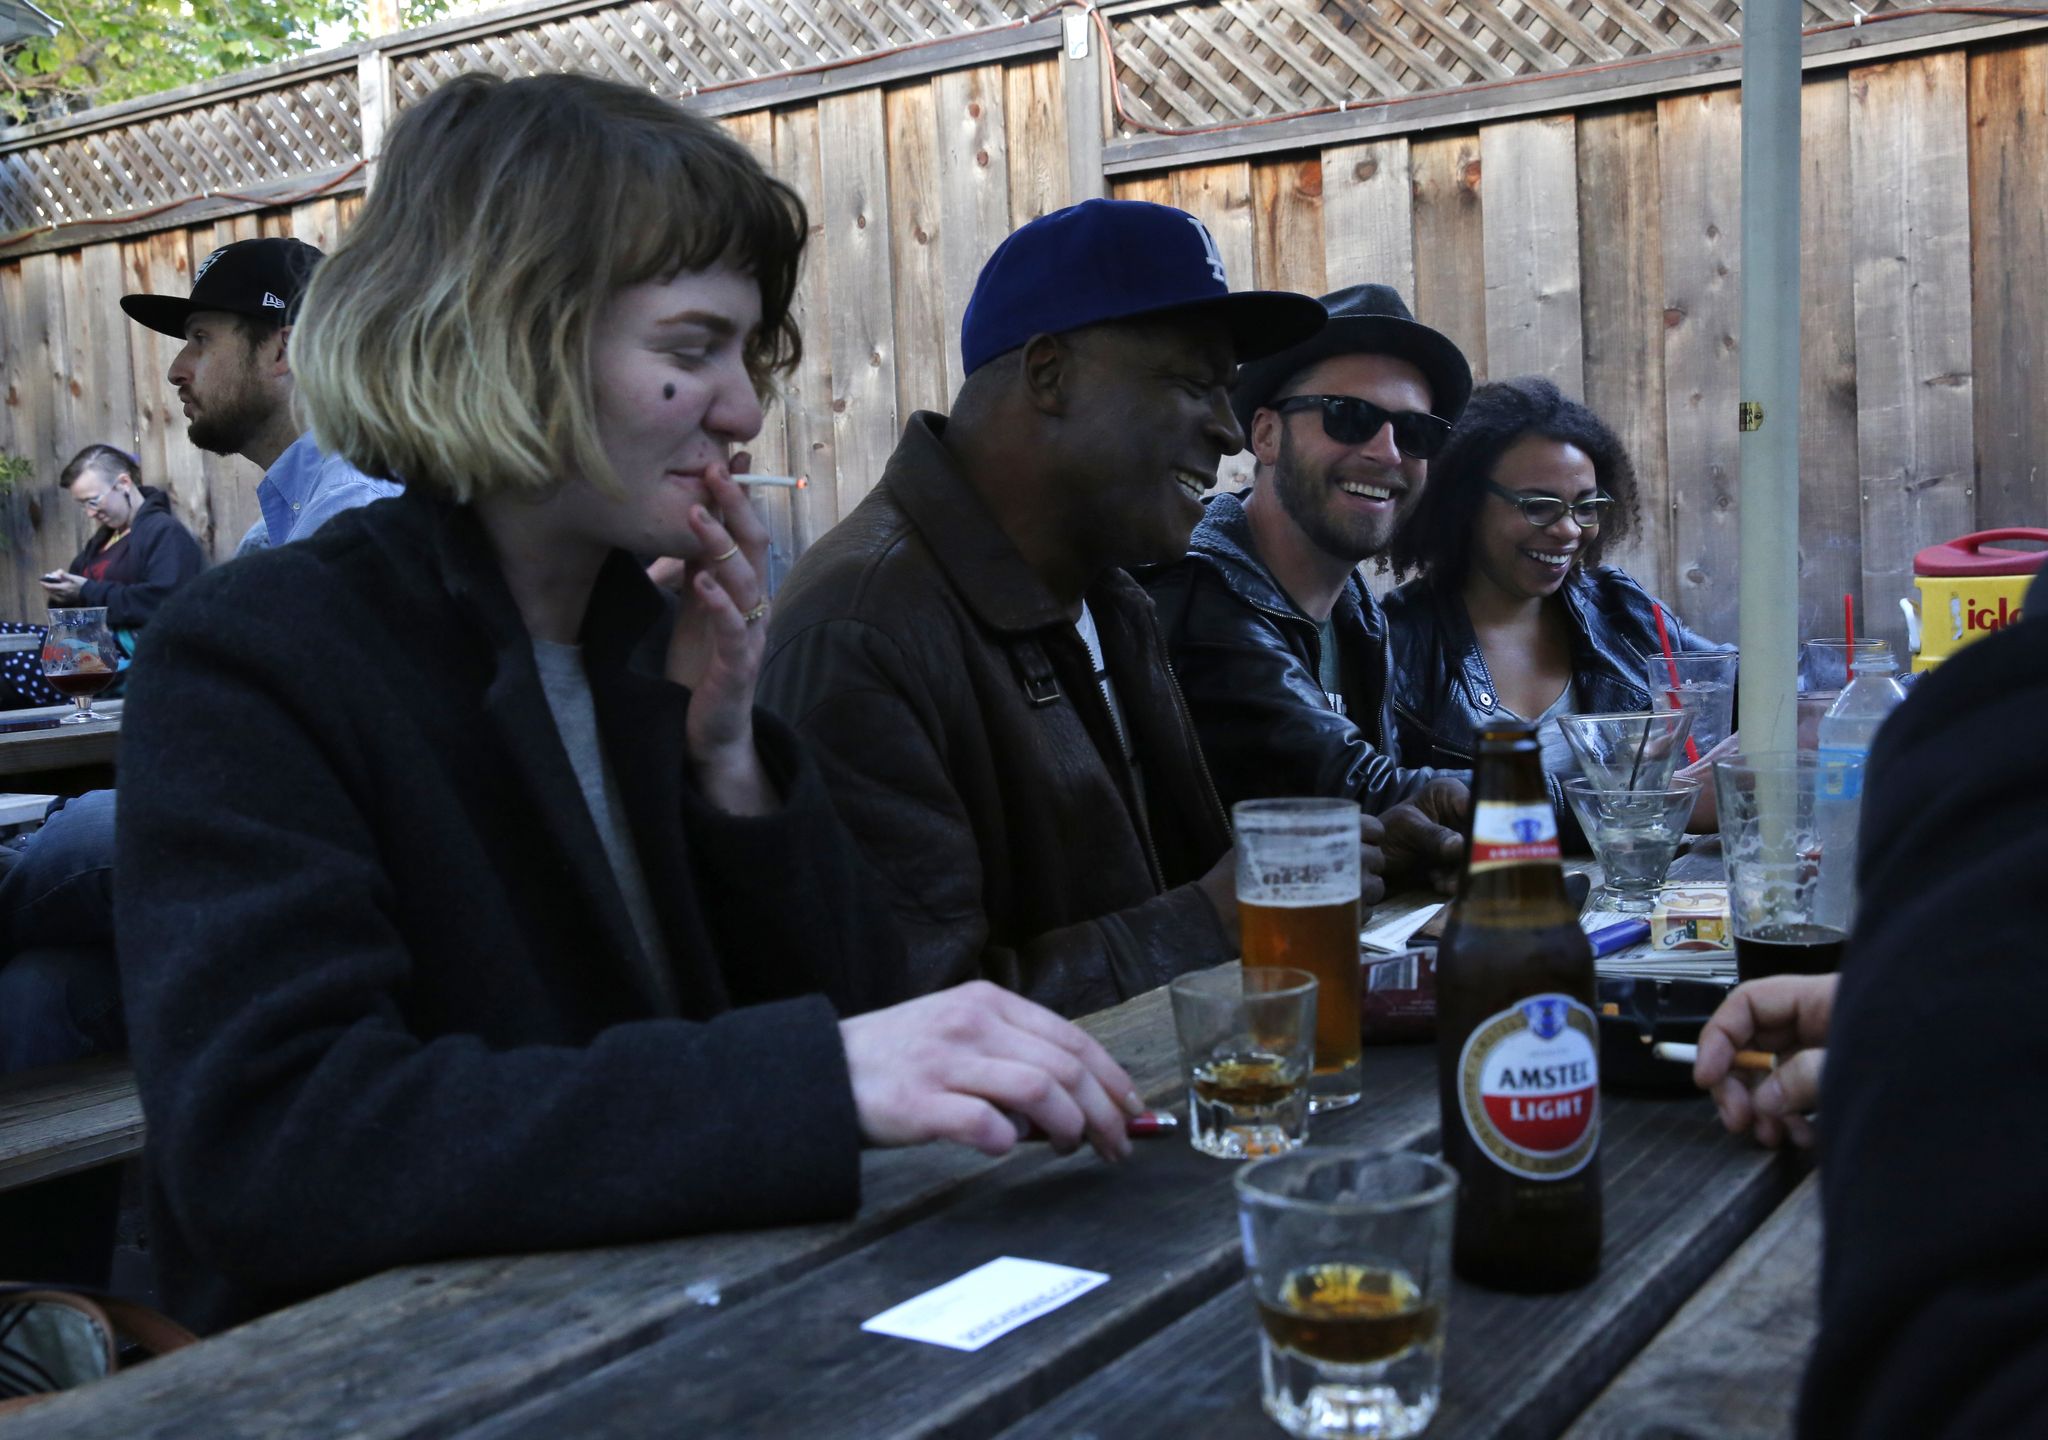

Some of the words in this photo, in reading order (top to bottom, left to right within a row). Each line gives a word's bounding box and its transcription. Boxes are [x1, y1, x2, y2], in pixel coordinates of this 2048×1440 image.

[1663, 928, 1729, 947] CAL
[1499, 1059, 1588, 1089] AMSTEL
[1510, 1096, 1583, 1122] LIGHT
